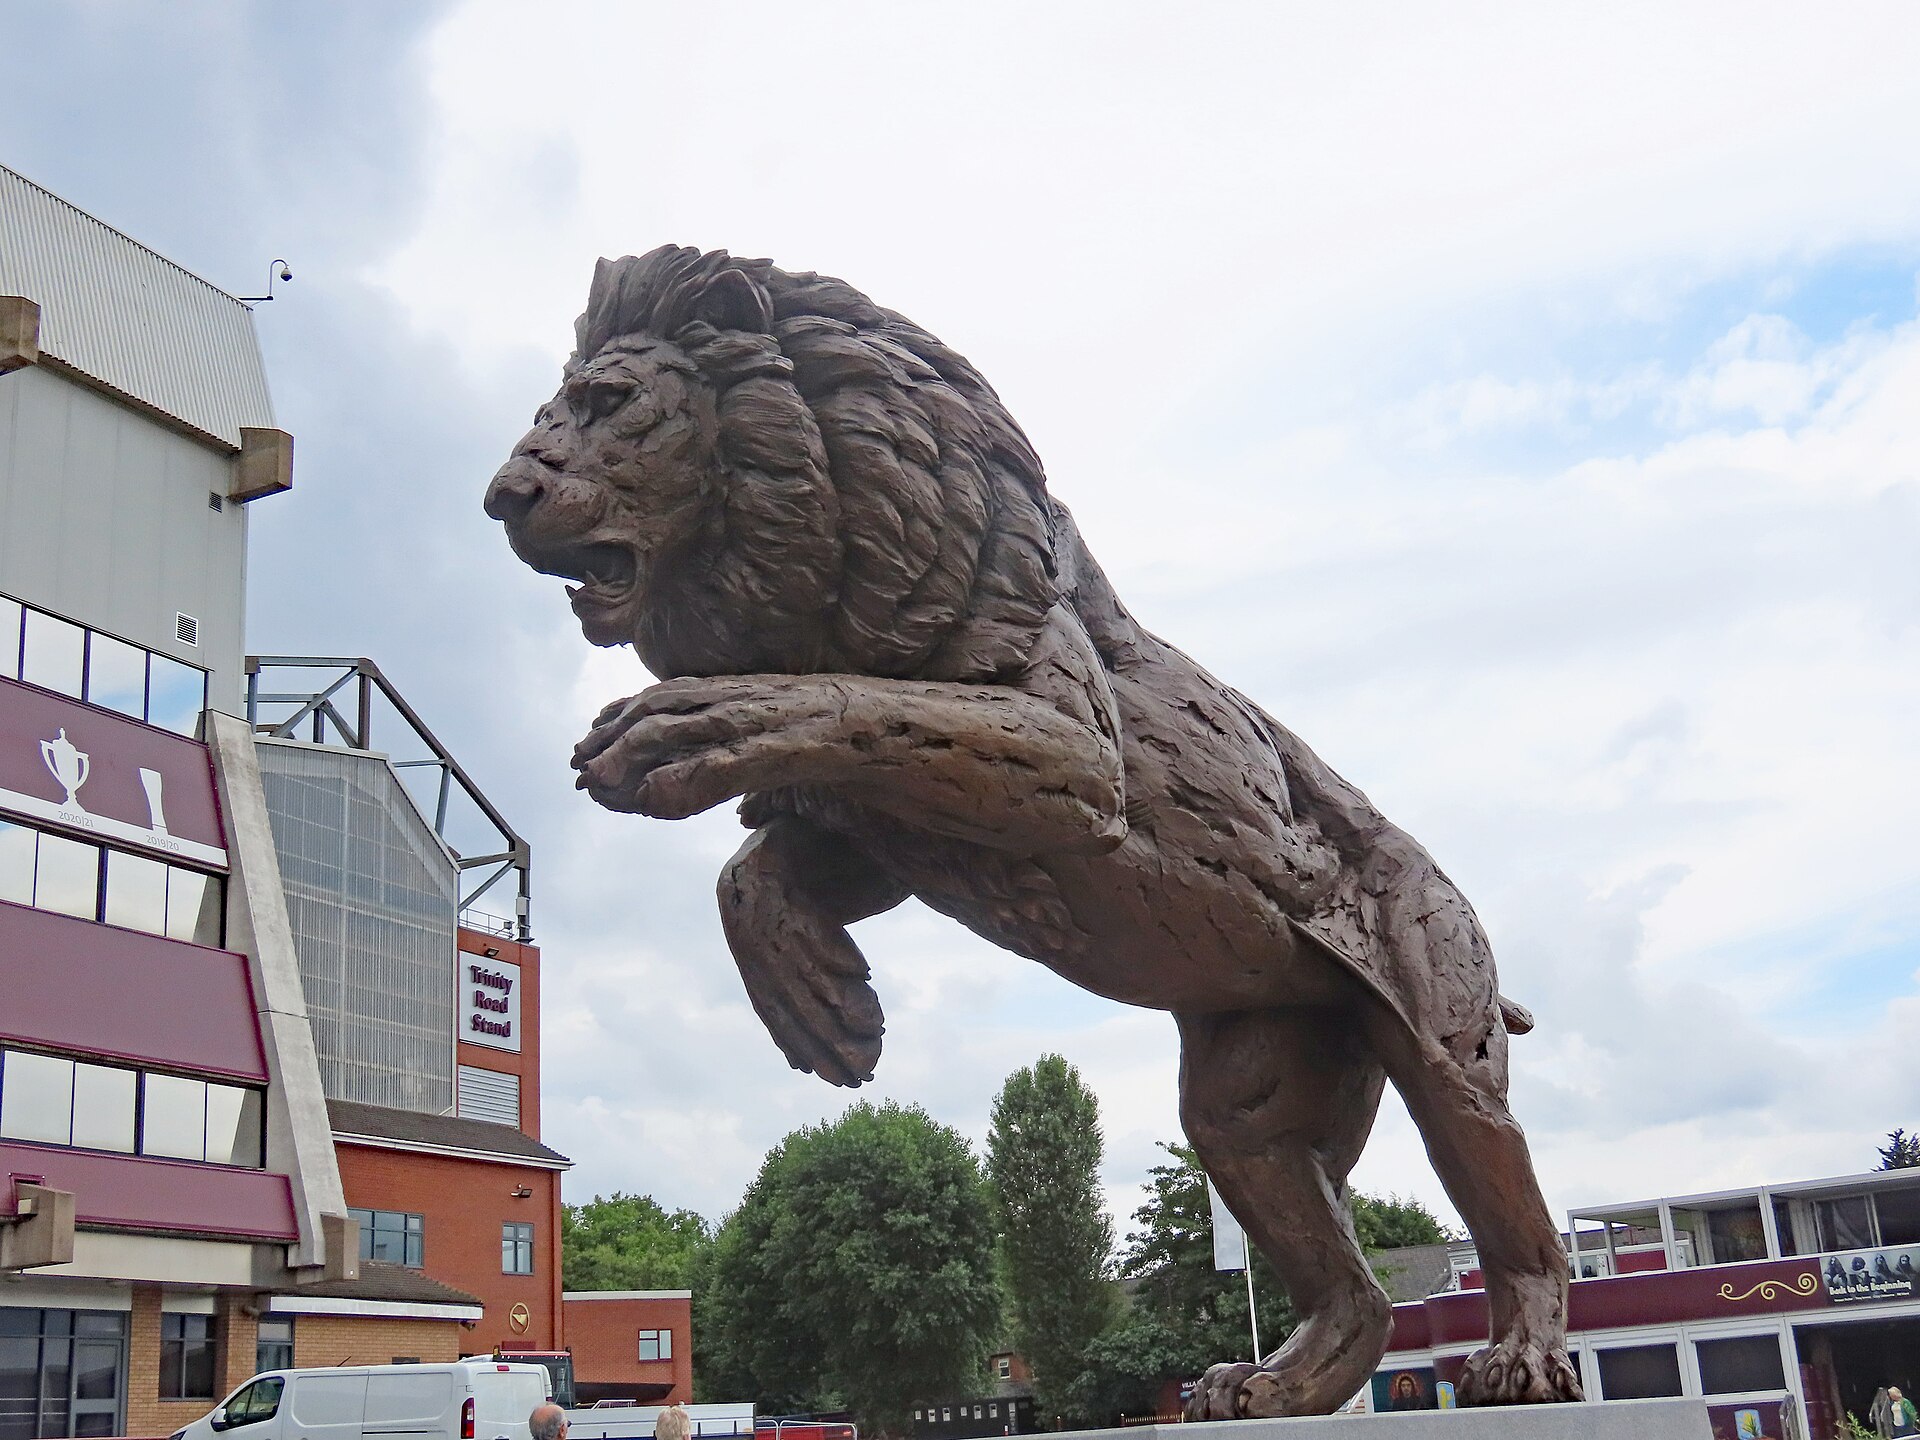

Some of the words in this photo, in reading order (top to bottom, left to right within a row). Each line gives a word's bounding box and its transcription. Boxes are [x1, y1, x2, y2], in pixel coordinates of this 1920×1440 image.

[469, 964, 513, 995] Trinity
[474, 990, 509, 1013] Road
[471, 1013, 512, 1037] Stand
[1847, 1285, 1856, 1293] to
[1856, 1283, 1870, 1292] the
[1870, 1279, 1912, 1292] Beginning
